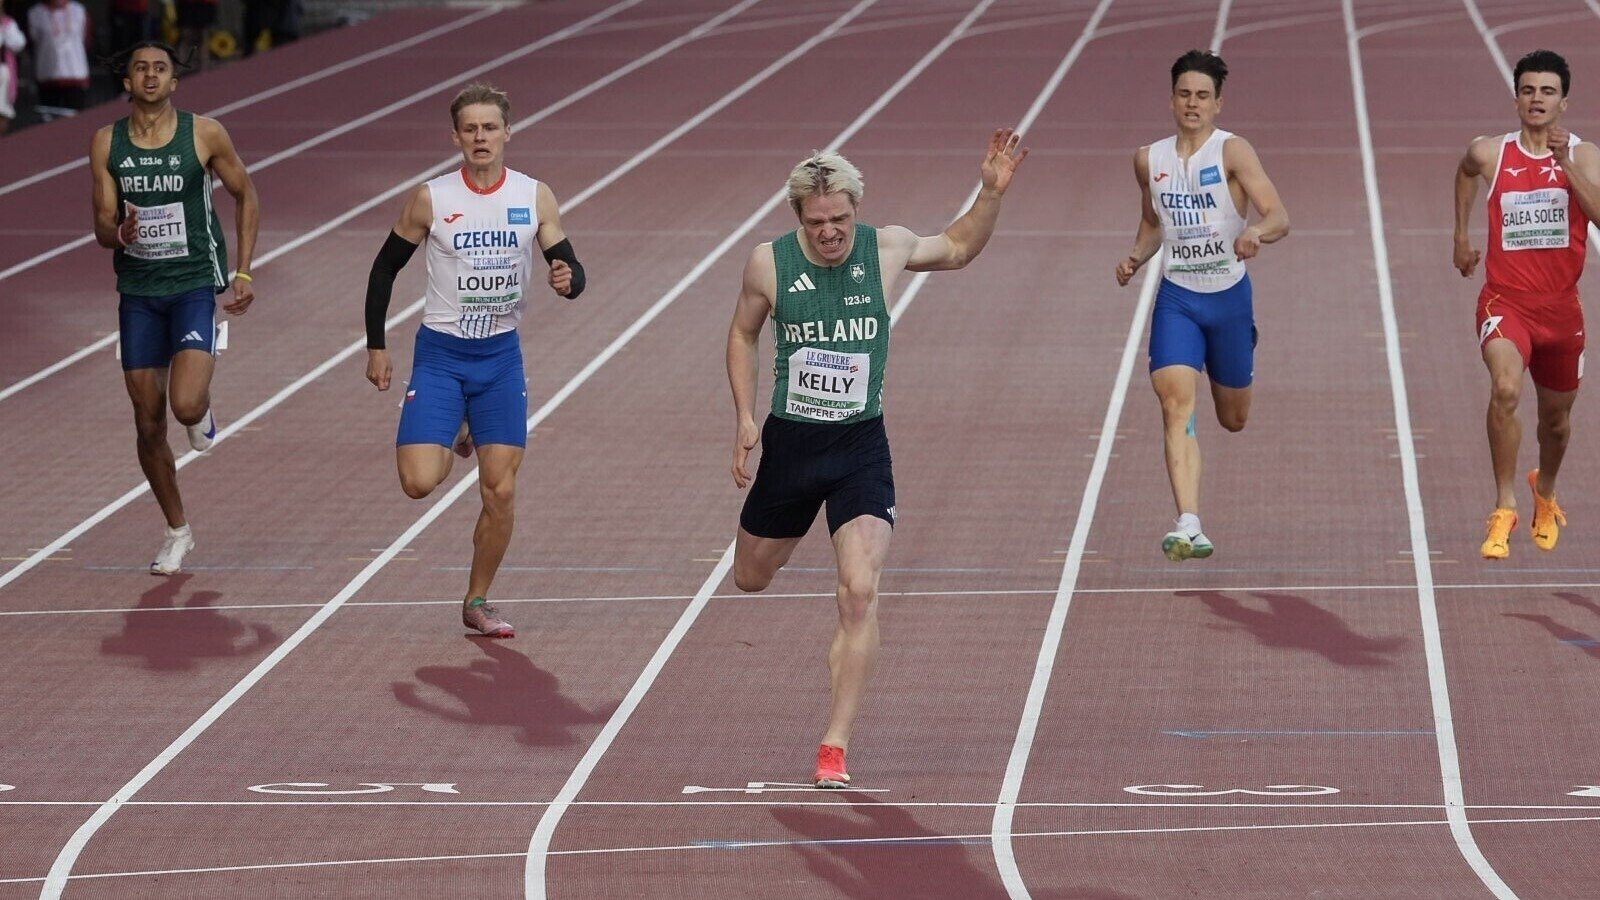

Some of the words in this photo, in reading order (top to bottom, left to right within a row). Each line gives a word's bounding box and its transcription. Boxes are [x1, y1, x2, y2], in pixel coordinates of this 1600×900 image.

[140, 157, 163, 166] 123.ie
[120, 175, 184, 193] IRELAND
[1161, 193, 1217, 209] CZECHIA
[1502, 210, 1532, 227] GALEA
[1534, 208, 1565, 224] SOLER
[138, 222, 182, 238] GGETT
[454, 231, 518, 250] CZECHIA
[1507, 239, 1544, 247] TAMPERE
[1546, 238, 1565, 246] 2025
[1172, 240, 1225, 260] HORÁK
[458, 273, 519, 291] LOUPAL
[844, 294, 872, 306] 123.ie
[461, 305, 503, 313] TAMPERE
[782, 317, 878, 343] IRELAND
[806, 351, 816, 361] LE
[798, 370, 855, 393] KELLY
[806, 397, 820, 406] RUN
[821, 400, 847, 408] CLEAN
[790, 403, 835, 419] TAMPERE
